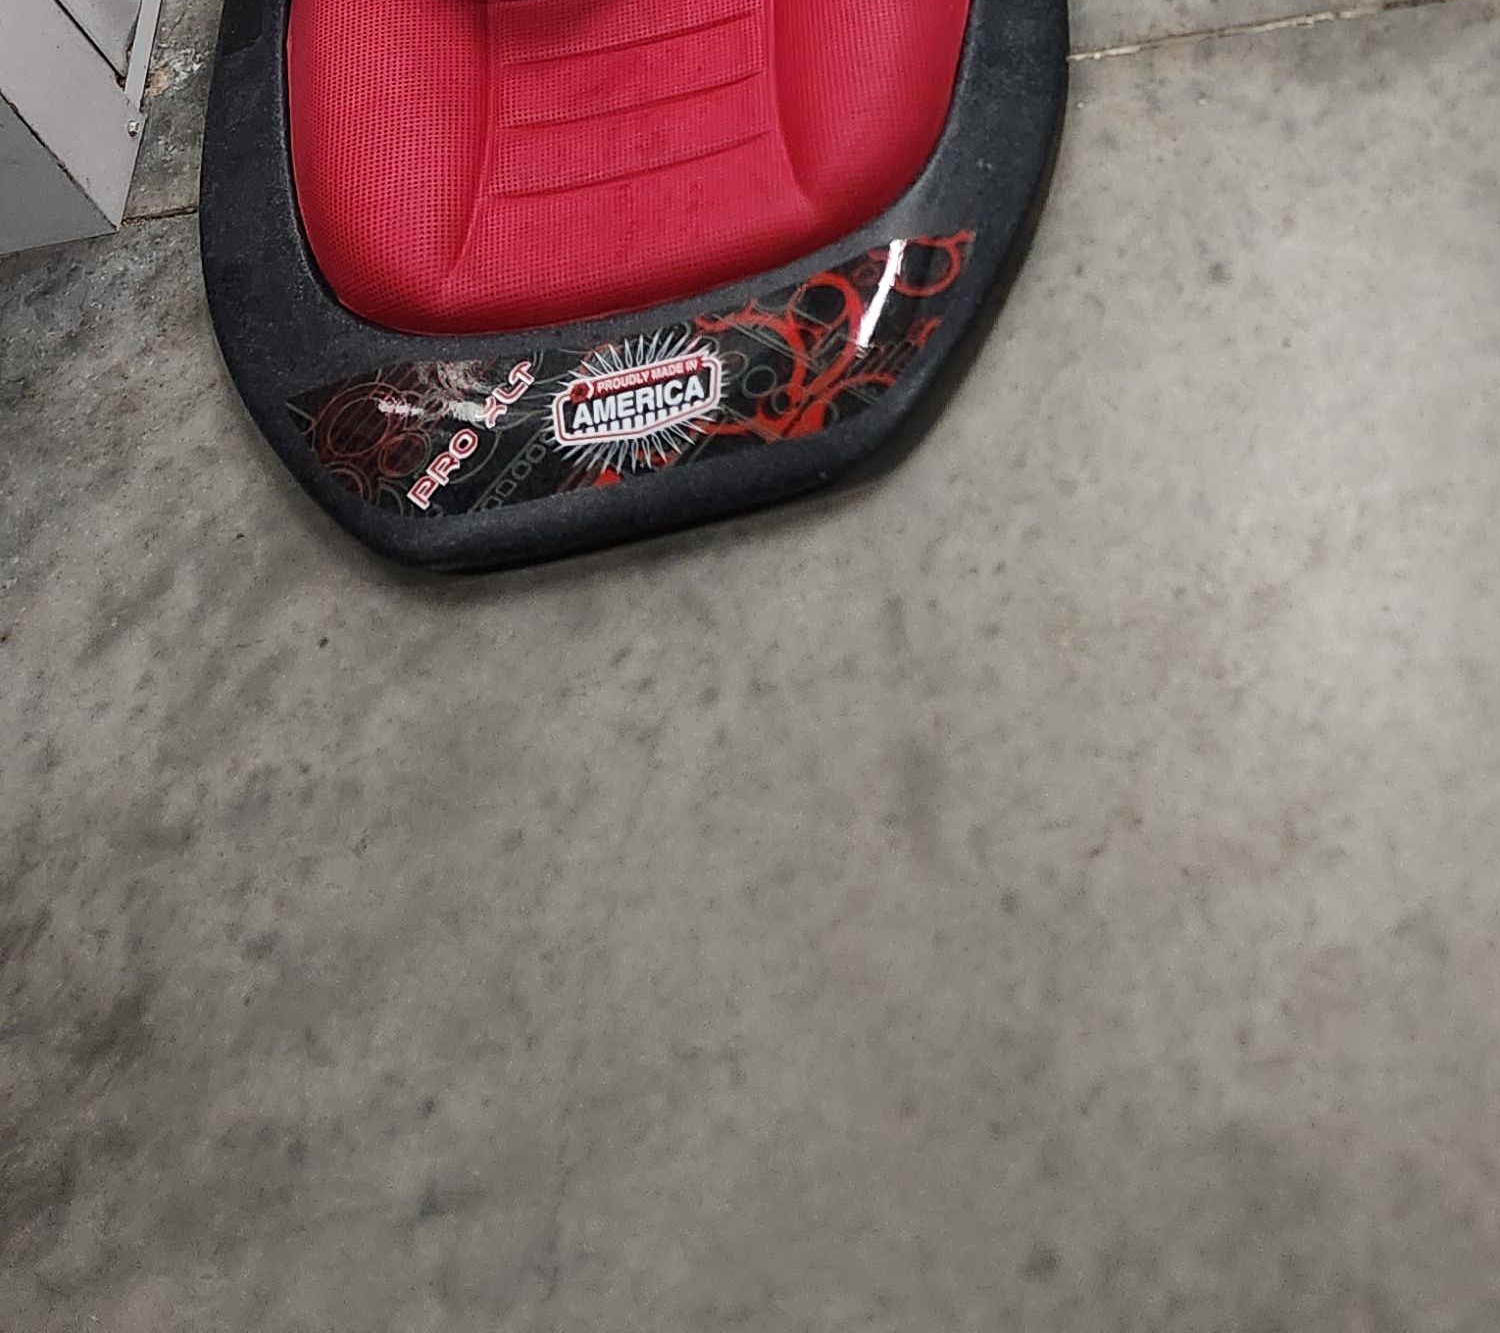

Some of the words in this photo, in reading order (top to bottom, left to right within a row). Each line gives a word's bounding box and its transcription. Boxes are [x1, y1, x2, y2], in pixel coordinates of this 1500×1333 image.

[572, 375, 706, 430] AMERICA
[596, 370, 650, 394] PROUDLY
[652, 361, 685, 380] MADE
[685, 358, 699, 374] IN
[406, 427, 479, 511] PRO
